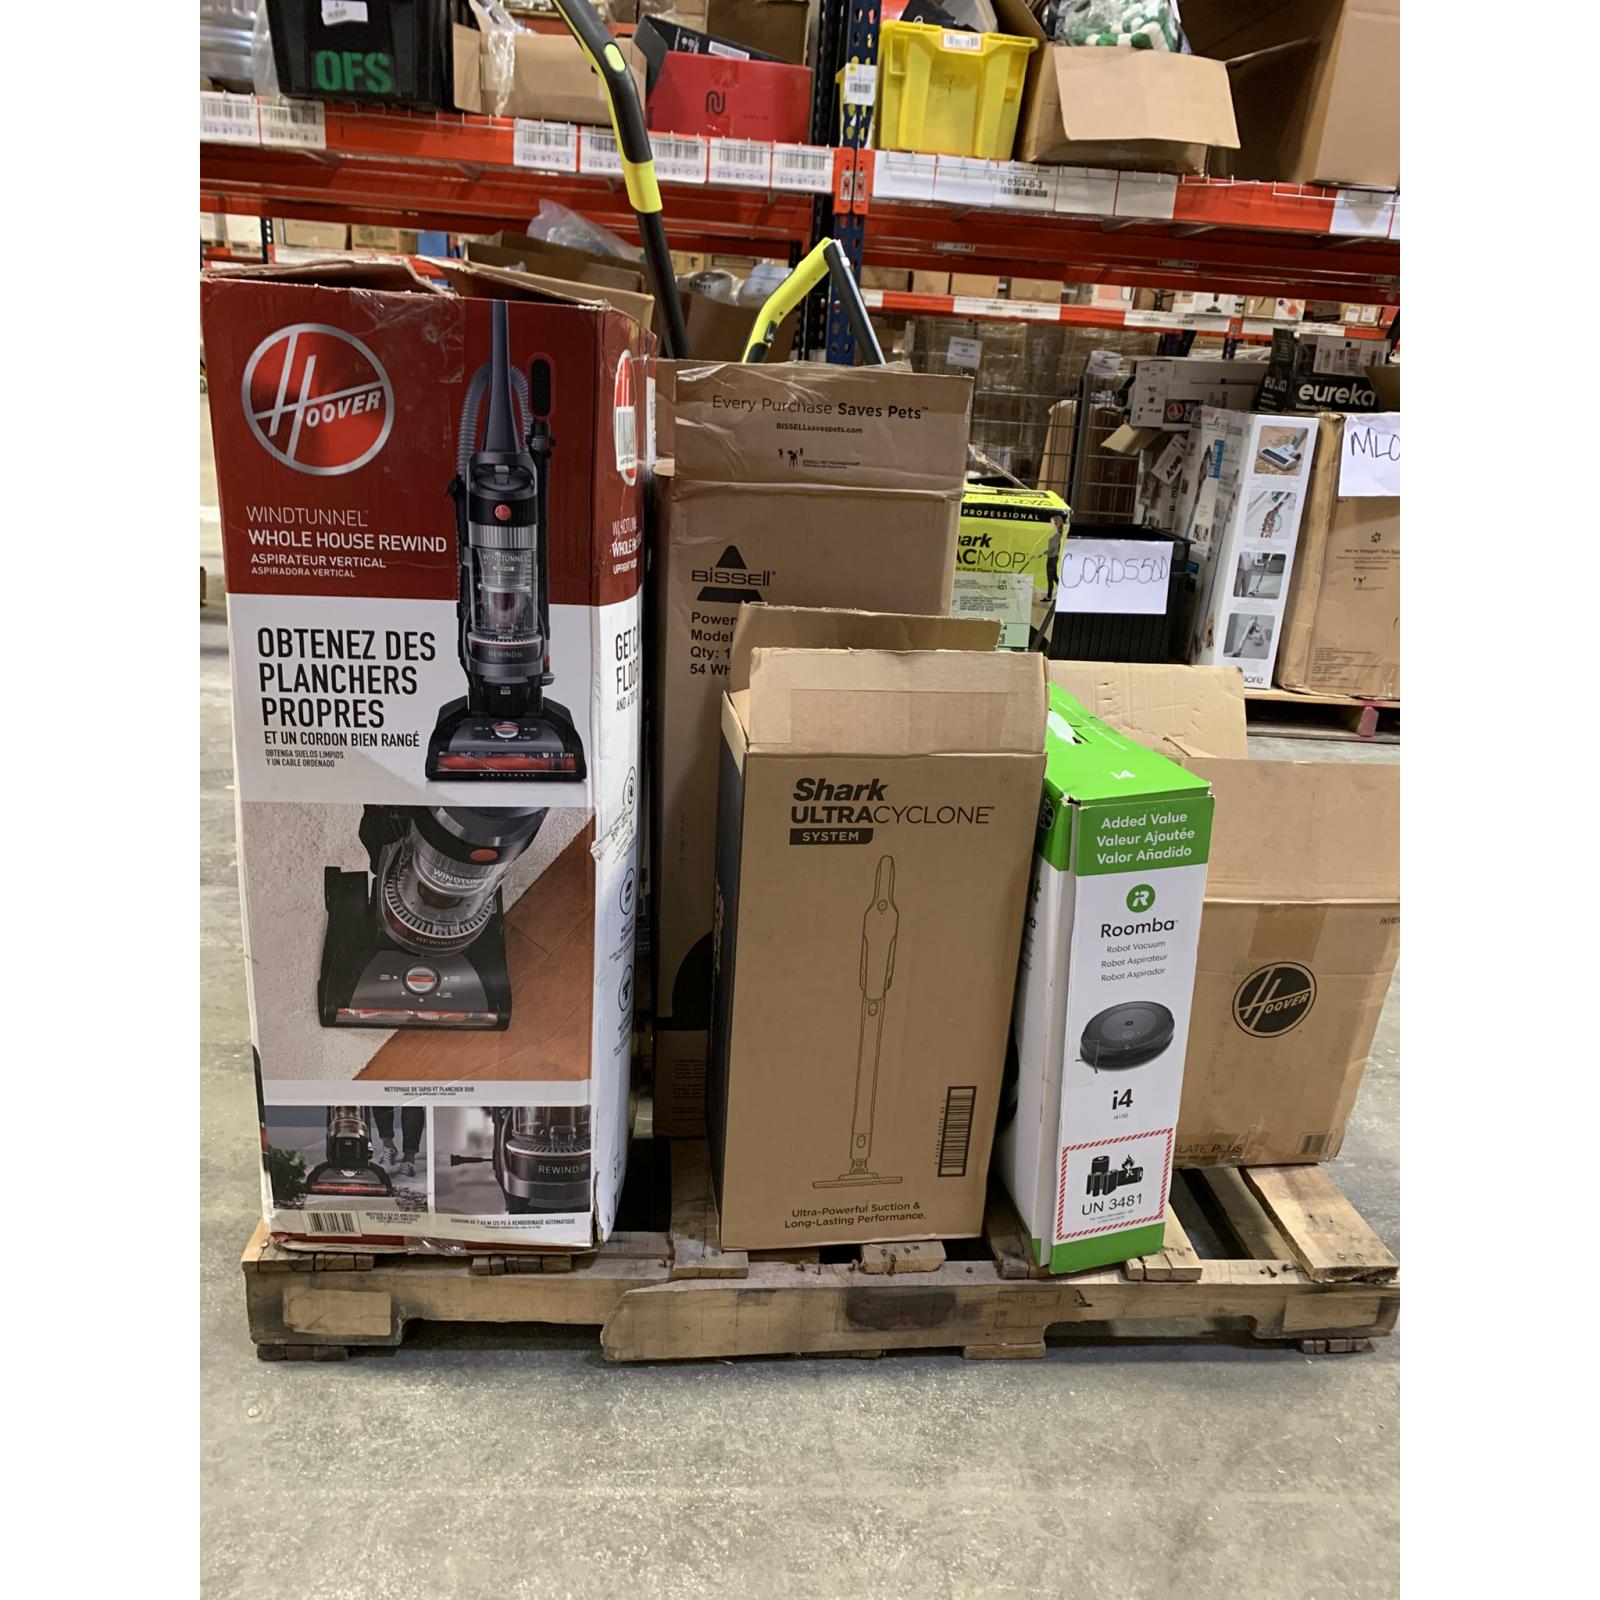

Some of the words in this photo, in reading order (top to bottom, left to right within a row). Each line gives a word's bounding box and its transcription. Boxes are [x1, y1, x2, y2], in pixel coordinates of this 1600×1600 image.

[315, 50, 392, 94] OFS
[1298, 382, 1376, 408] eureka
[712, 395, 756, 413] Every
[762, 397, 832, 415] Purchase
[837, 402, 882, 417] Saves
[776, 422, 863, 434] BISSELLsavespets.com
[246, 505, 369, 527] WINDTUNNEL
[963, 508, 1040, 521] PROFESSIONAL
[247, 528, 313, 548] WHOLE
[316, 531, 375, 550] HOUSE
[379, 534, 447, 553] REWIND
[250, 553, 327, 566] ASPIRATEUR
[329, 555, 387, 568] VERTICAL
[251, 566, 310, 577] ASPIRADORA
[312, 568, 356, 578] VERTICAL
[691, 611, 737, 626] Power
[691, 629, 734, 642] Model
[257, 627, 377, 660] OBTENEZ
[385, 630, 436, 662] DES
[615, 629, 632, 662] GET
[690, 646, 719, 661] Qty:
[690, 663, 706, 675] 54
[259, 662, 418, 696] PLANCHERS
[261, 697, 385, 729] PROPRES
[264, 730, 277, 745] ET
[281, 731, 297, 745] UN
[300, 731, 348, 746] CORDON
[351, 732, 378, 747] BIEN
[381, 731, 420, 747] RANGÉ
[265, 749, 293, 758] OBTENGA
[294, 749, 318, 758] SUELOS
[266, 758, 271, 767] Y
[272, 758, 281, 766] UN
[282, 758, 301, 767] CABLE
[302, 759, 335, 768] ORDENADO
[793, 777, 889, 801] Shark
[790, 805, 991, 825] ULTRACYCLONE
[1101, 814, 1147, 830] Added
[1150, 812, 1188, 825] Value
[802, 831, 859, 842] SYSTEM
[1096, 834, 1141, 847] Valeur
[1144, 828, 1196, 846] Ajoutée
[1096, 852, 1133, 865] Valor
[1136, 845, 1192, 861] Añadido
[1100, 917, 1175, 938] Roomba
[1106, 944, 1131, 953] Robot
[1132, 941, 1166, 951] Vacuum
[1101, 958, 1126, 968] Robot
[1127, 954, 1168, 966] Aspirateur
[1101, 972, 1126, 982] Robot
[1127, 967, 1166, 979] Aspirador
[1112, 1088, 1133, 1110] i4
[538, 1164, 579, 1175] REWIND
[791, 1204, 868, 1218] Ultra-Powerful
[871, 1202, 910, 1213] Suction
[912, 1201, 920, 1209] &
[1082, 1200, 1105, 1216] UN
[1108, 1193, 1143, 1211] 3481
[784, 1216, 855, 1229] Long-Lasting
[857, 1212, 927, 1224] Performance.
